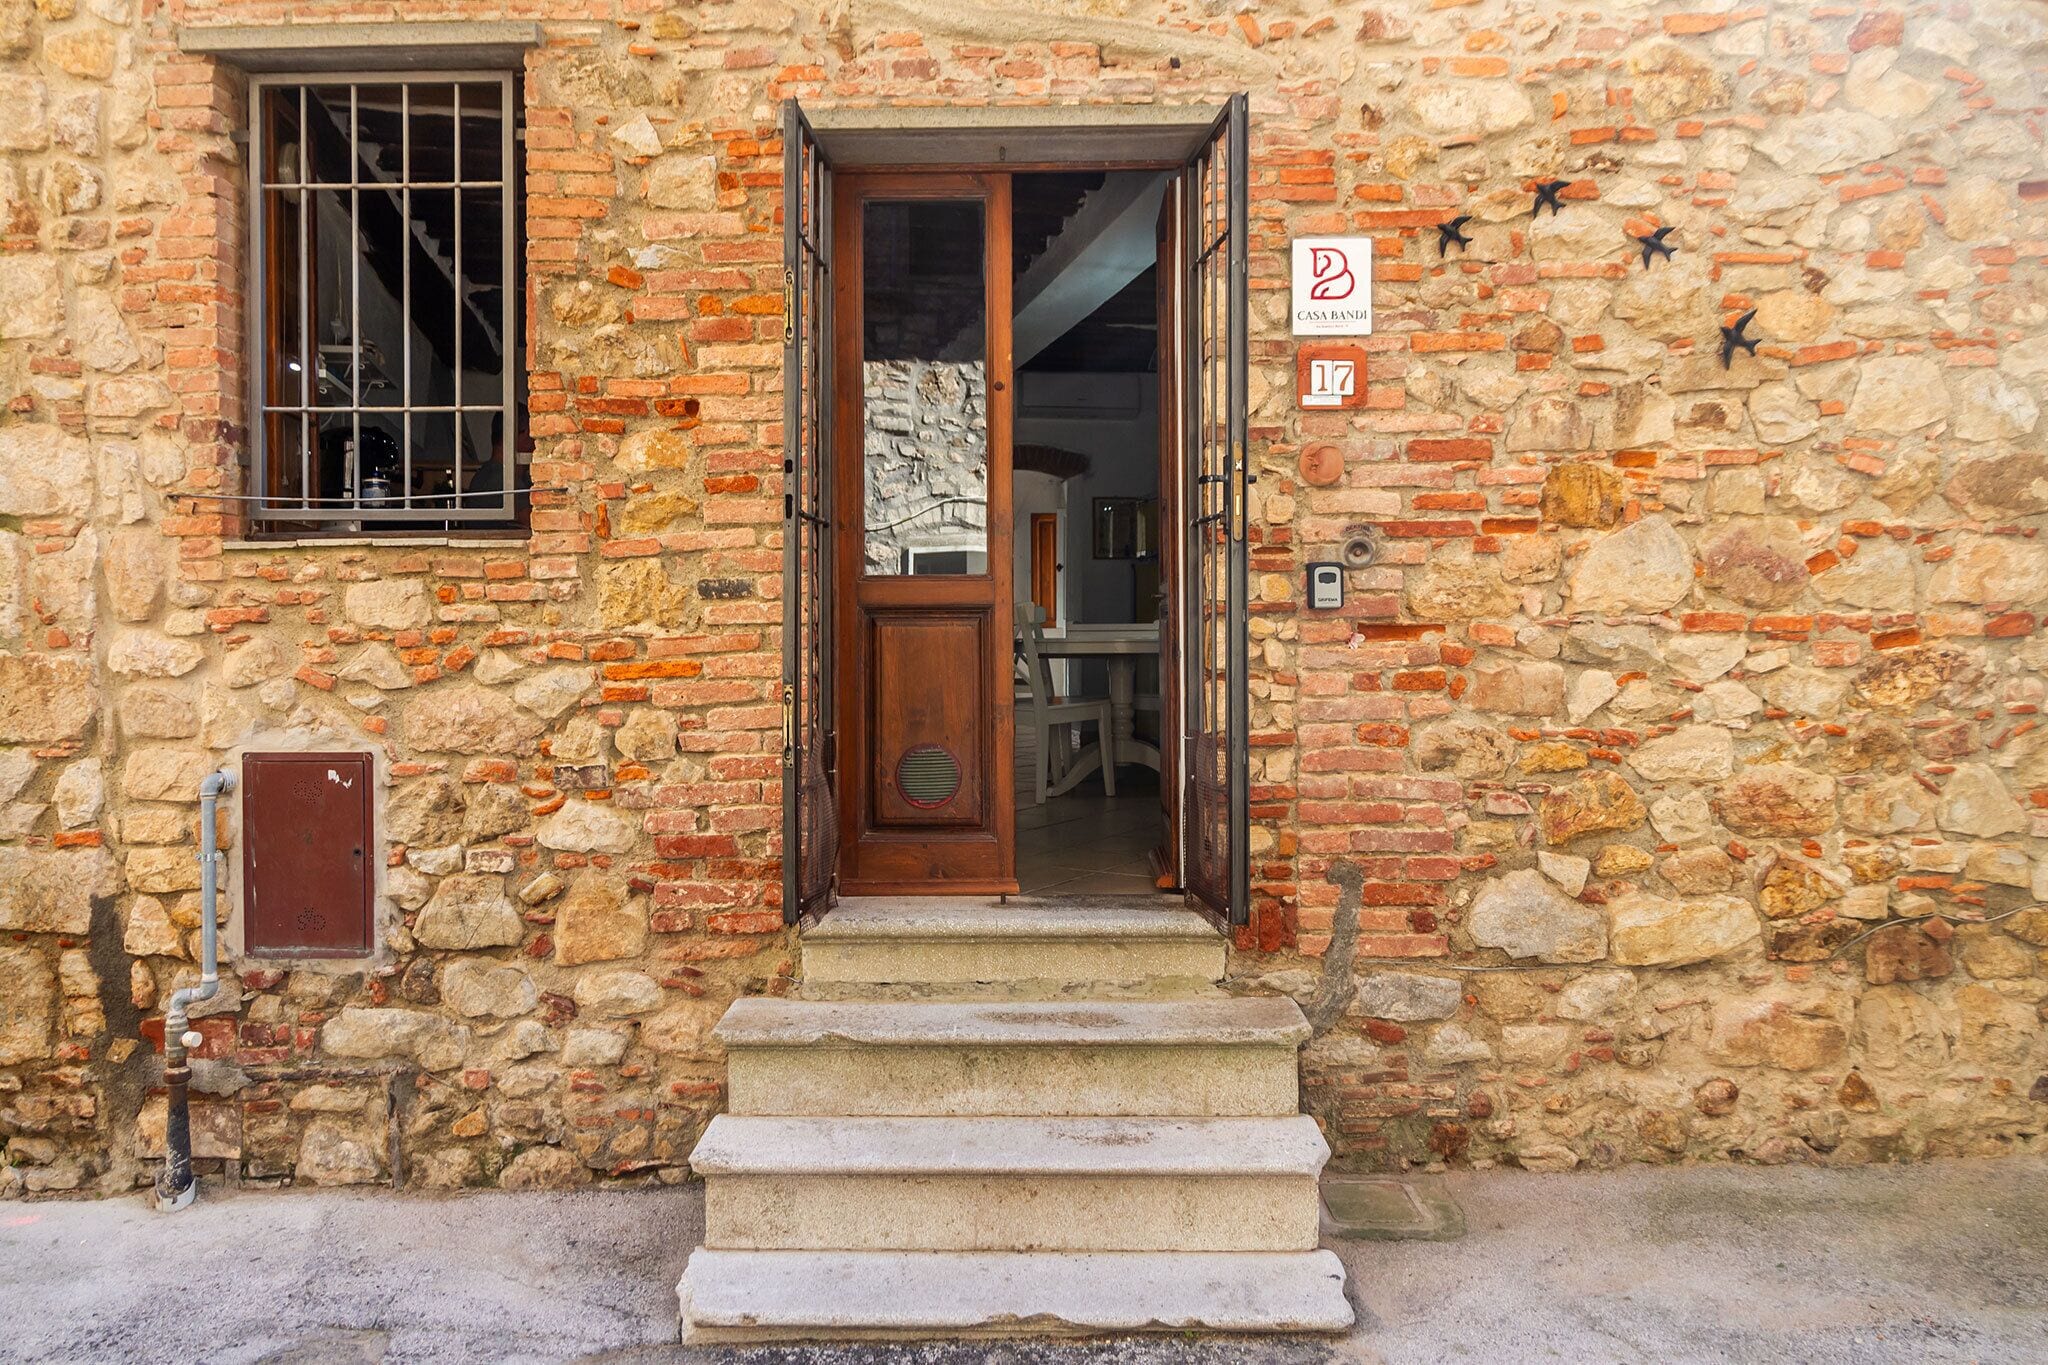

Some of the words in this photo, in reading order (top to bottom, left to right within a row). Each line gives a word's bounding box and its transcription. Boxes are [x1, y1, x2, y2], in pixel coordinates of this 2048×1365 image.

[1297, 310, 1327, 321] CASA
[1330, 310, 1367, 320] BANDI
[1315, 364, 1353, 392] 17
